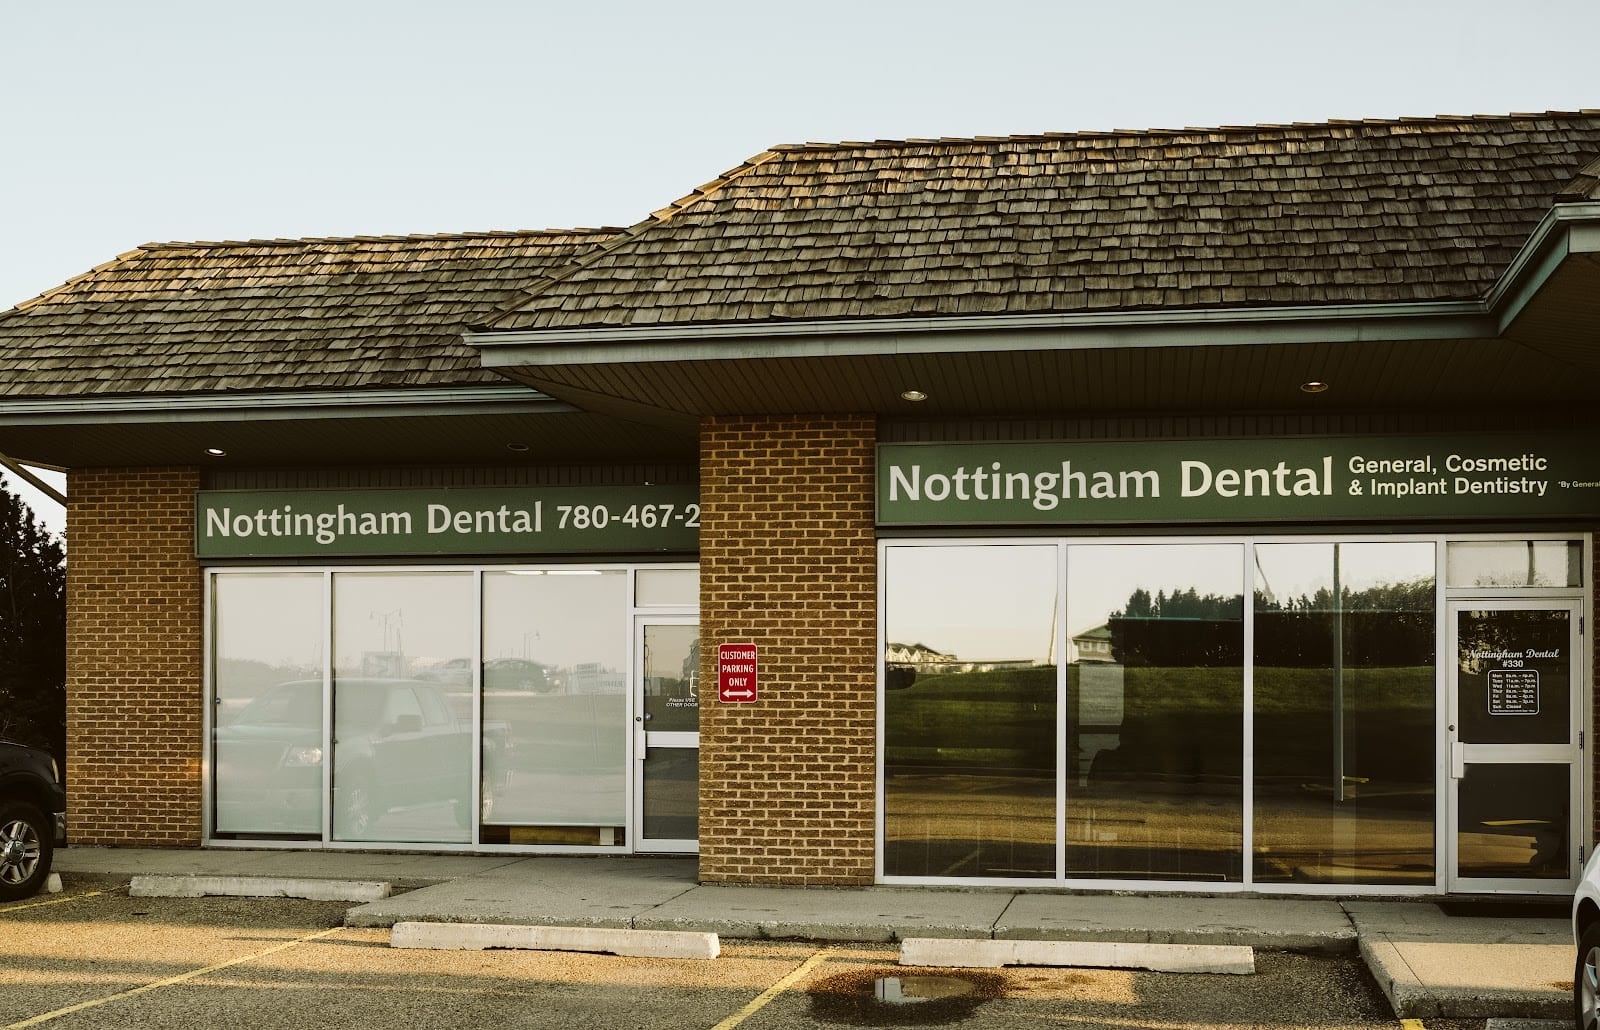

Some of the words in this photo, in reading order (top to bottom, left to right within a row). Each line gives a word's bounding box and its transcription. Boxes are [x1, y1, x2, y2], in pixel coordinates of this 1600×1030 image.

[1349, 456, 1437, 476] General,
[1446, 454, 1547, 473] Cosmetic
[889, 461, 1160, 511] Nottingham
[1181, 456, 1333, 498] Dental
[1349, 479, 1363, 496] &
[1372, 478, 1447, 498] Implant
[1455, 477, 1548, 497] Dentistry
[206, 504, 413, 544] Nottingham
[428, 501, 542, 534] Dental
[557, 504, 700, 532] 780-467-2
[720, 651, 756, 660] CUSTOMER
[1469, 648, 1523, 661] Nottingham
[1525, 648, 1560, 658] Dental
[722, 664, 754, 673] PARKING
[1502, 660, 1524, 668] #330
[728, 677, 748, 687] ONLY
